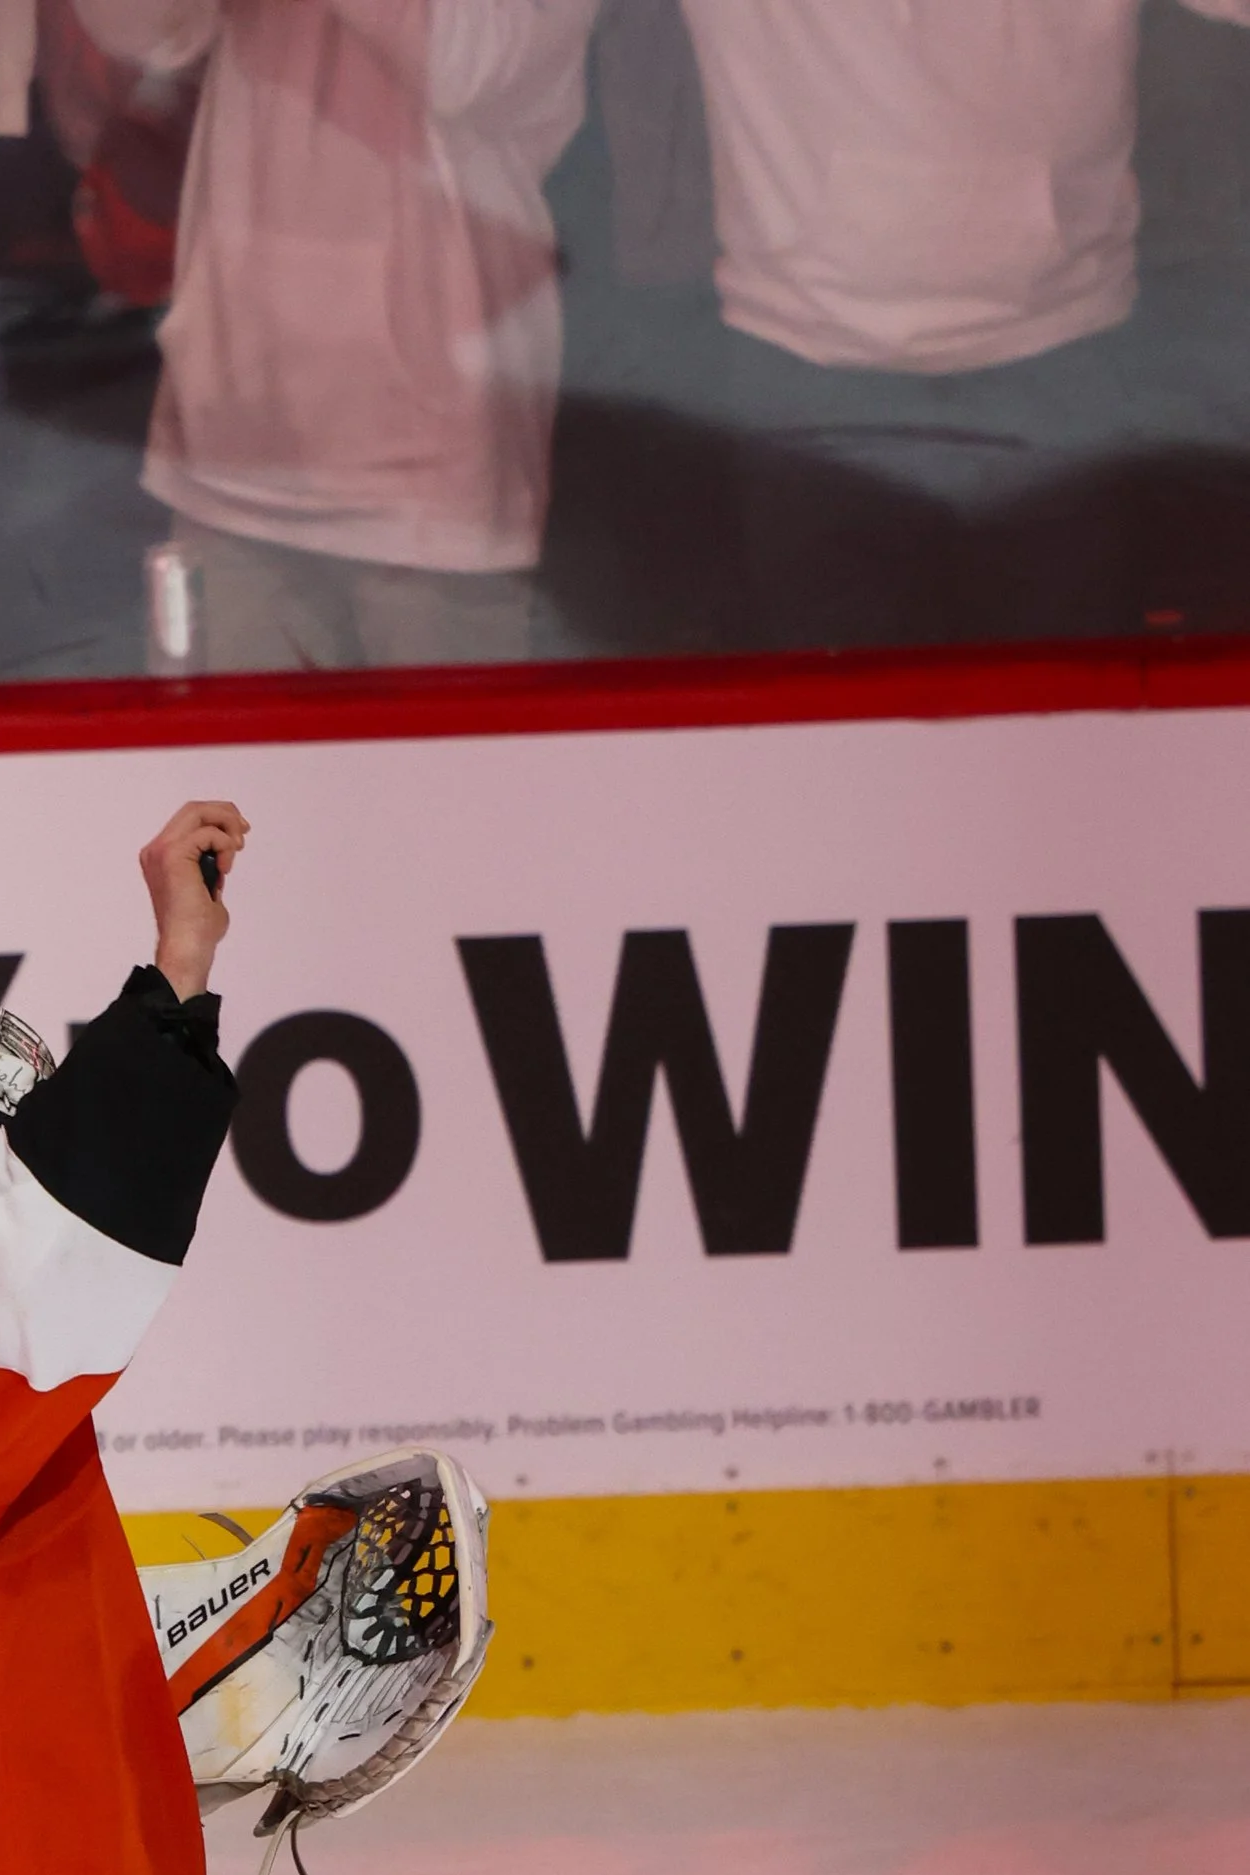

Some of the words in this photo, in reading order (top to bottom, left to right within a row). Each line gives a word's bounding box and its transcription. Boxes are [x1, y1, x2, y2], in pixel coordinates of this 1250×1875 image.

[456, 908, 1250, 1262] WIN
[218, 1424, 296, 1449] Please
[303, 1423, 351, 1448] play
[507, 1413, 605, 1436] Problem
[613, 1409, 726, 1436] Gambling
